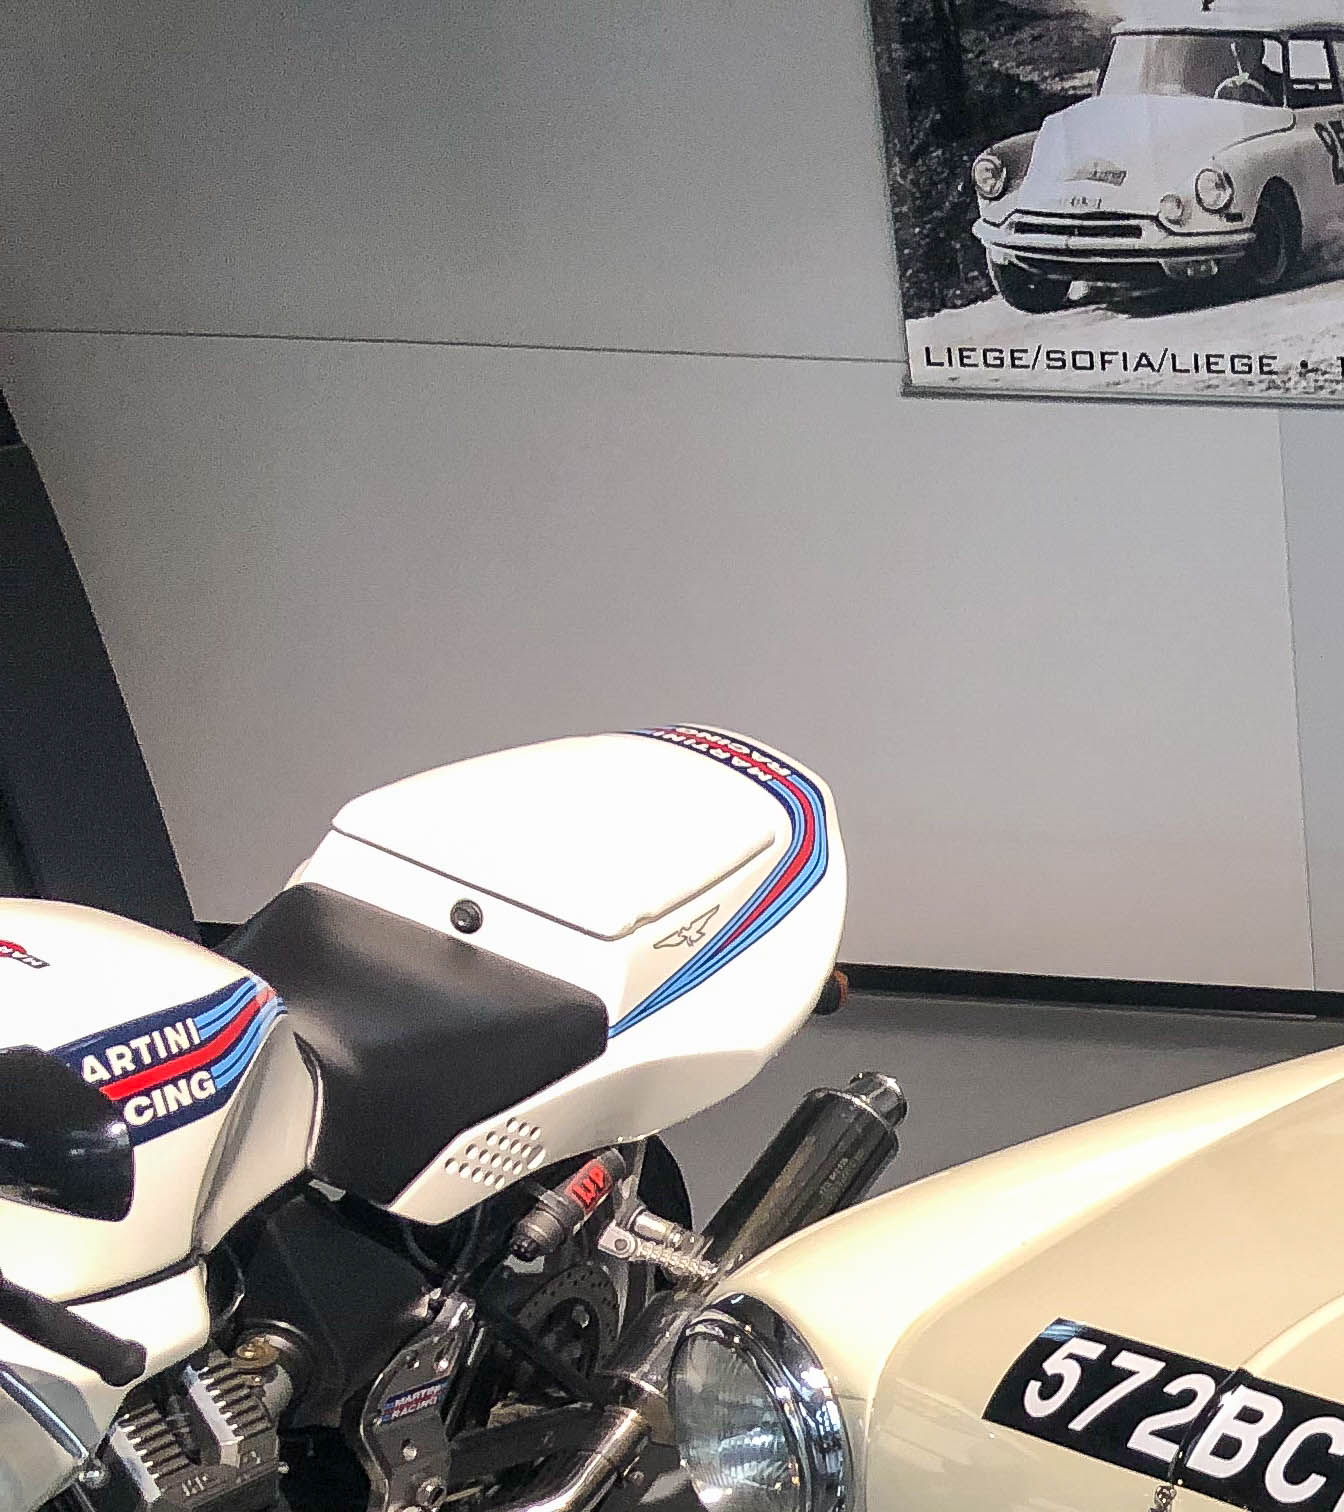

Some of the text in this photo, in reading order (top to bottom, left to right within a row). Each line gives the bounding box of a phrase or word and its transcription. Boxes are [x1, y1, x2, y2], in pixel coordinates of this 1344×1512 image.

[922, 344, 1279, 377] LIEGE/SOFIA/LIEGE
[652, 730, 774, 783] MARTINI
[674, 726, 792, 777] RACING
[81, 1016, 202, 1084] ARTINI
[123, 1070, 218, 1127] CING
